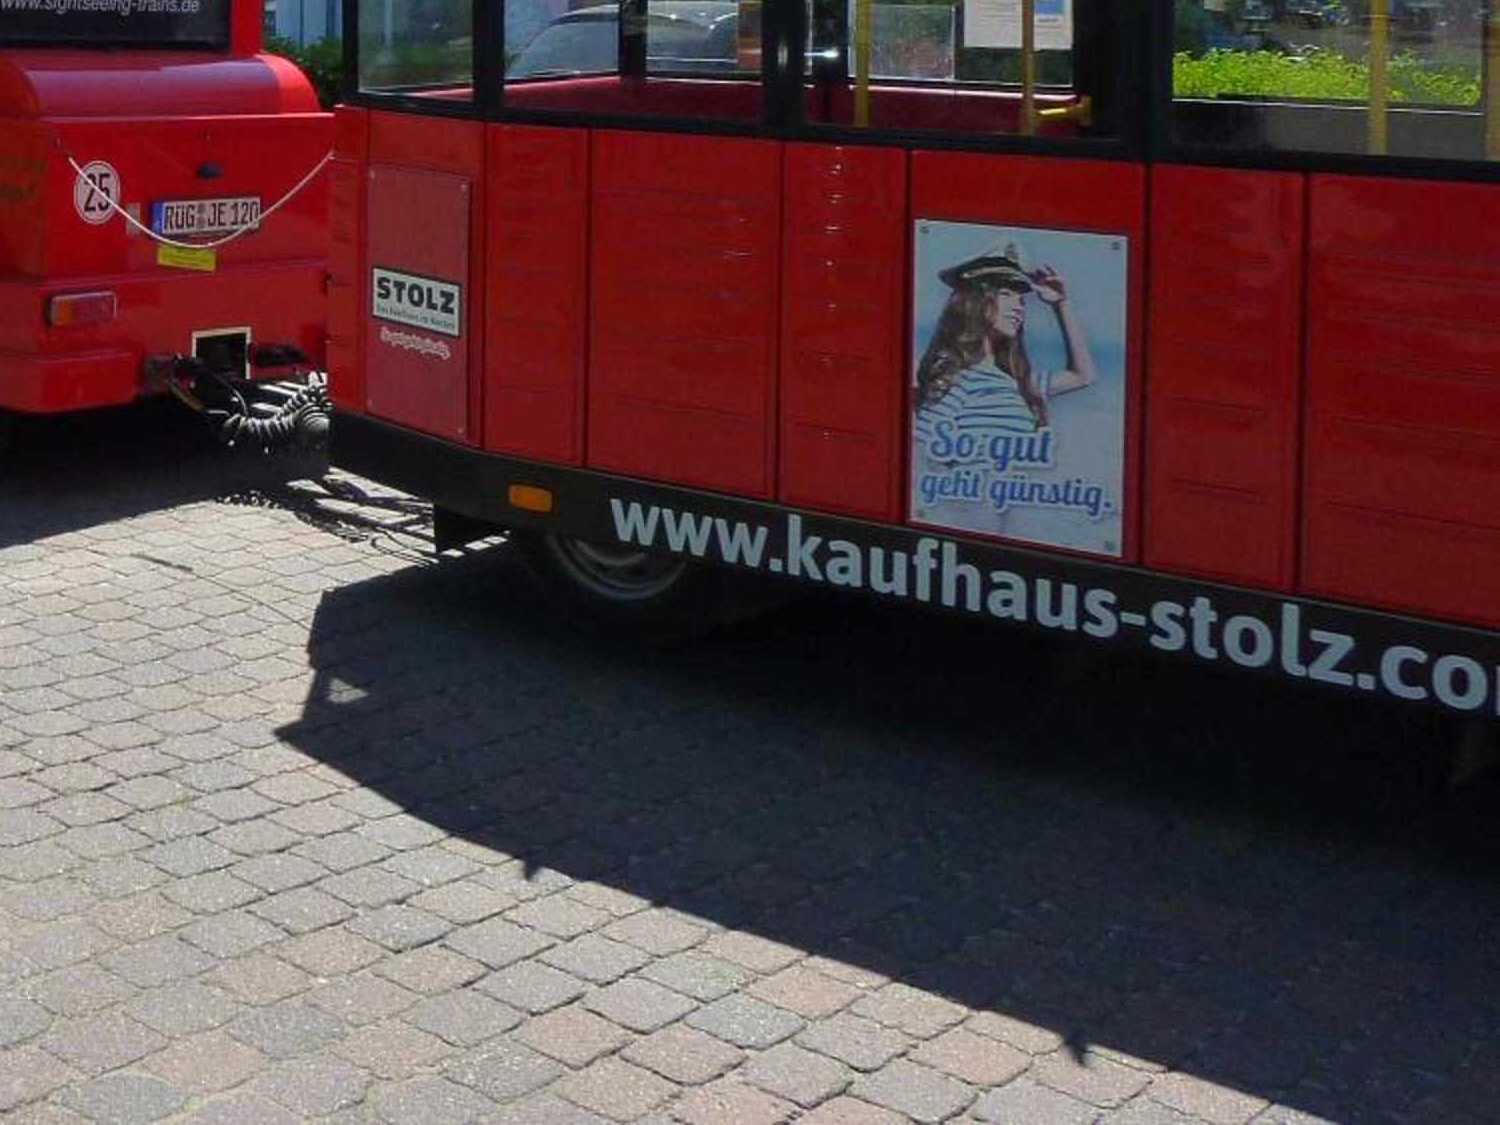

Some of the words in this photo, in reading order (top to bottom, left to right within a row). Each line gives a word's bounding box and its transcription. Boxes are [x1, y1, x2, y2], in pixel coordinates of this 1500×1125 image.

[83, 171, 112, 213] 25
[164, 203, 196, 231] RÜG
[208, 201, 227, 227] JE
[230, 200, 259, 226] 120
[377, 276, 455, 315] STOLZ
[931, 421, 974, 457] So
[989, 431, 1052, 472] gut
[920, 470, 981, 503] geht
[989, 475, 1111, 516] günstig.
[610, 498, 1500, 715] www.kaufhaus-stolz.co
